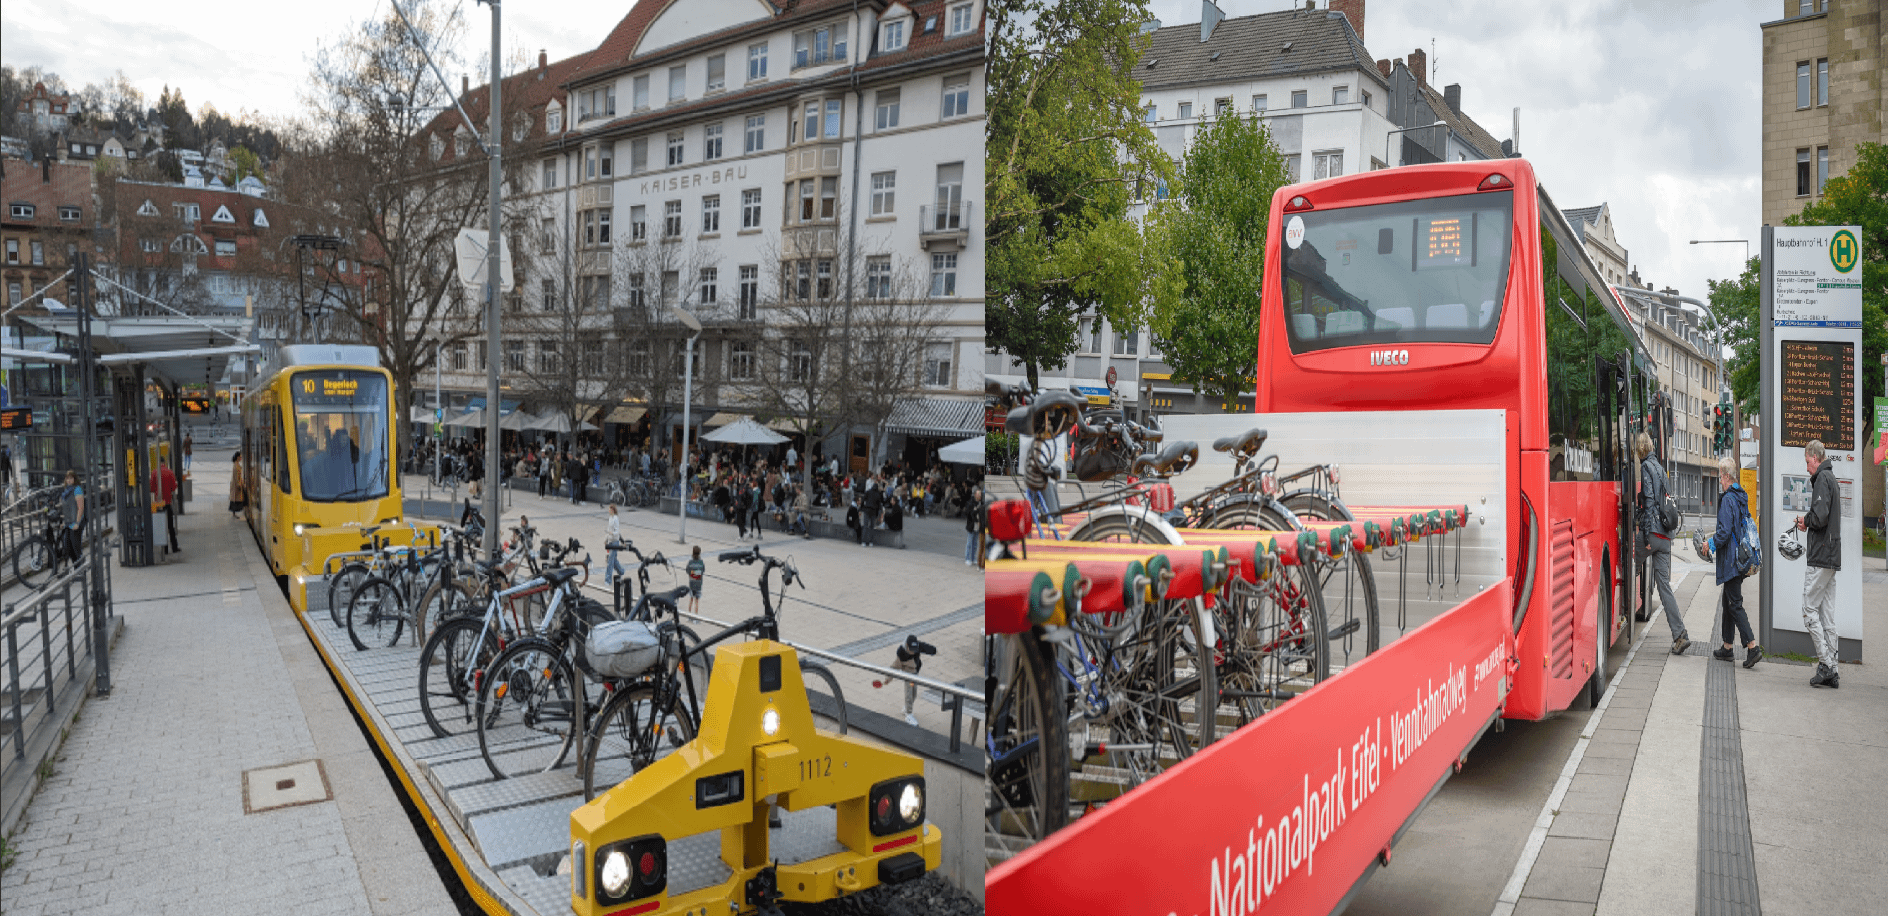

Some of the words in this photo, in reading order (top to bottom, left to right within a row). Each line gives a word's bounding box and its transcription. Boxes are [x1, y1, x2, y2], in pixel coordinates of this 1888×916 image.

[1776, 238, 1815, 249] Hauptbahnhof
[1836, 239, 1851, 263] H
[1370, 349, 1409, 366] IVECO
[302, 379, 315, 393] 10
[798, 755, 832, 781] 1112
[1209, 748, 1346, 916] Nationalpark
[1352, 717, 1381, 811] Eifel
[1391, 662, 1467, 771] Vennbahnradweg
